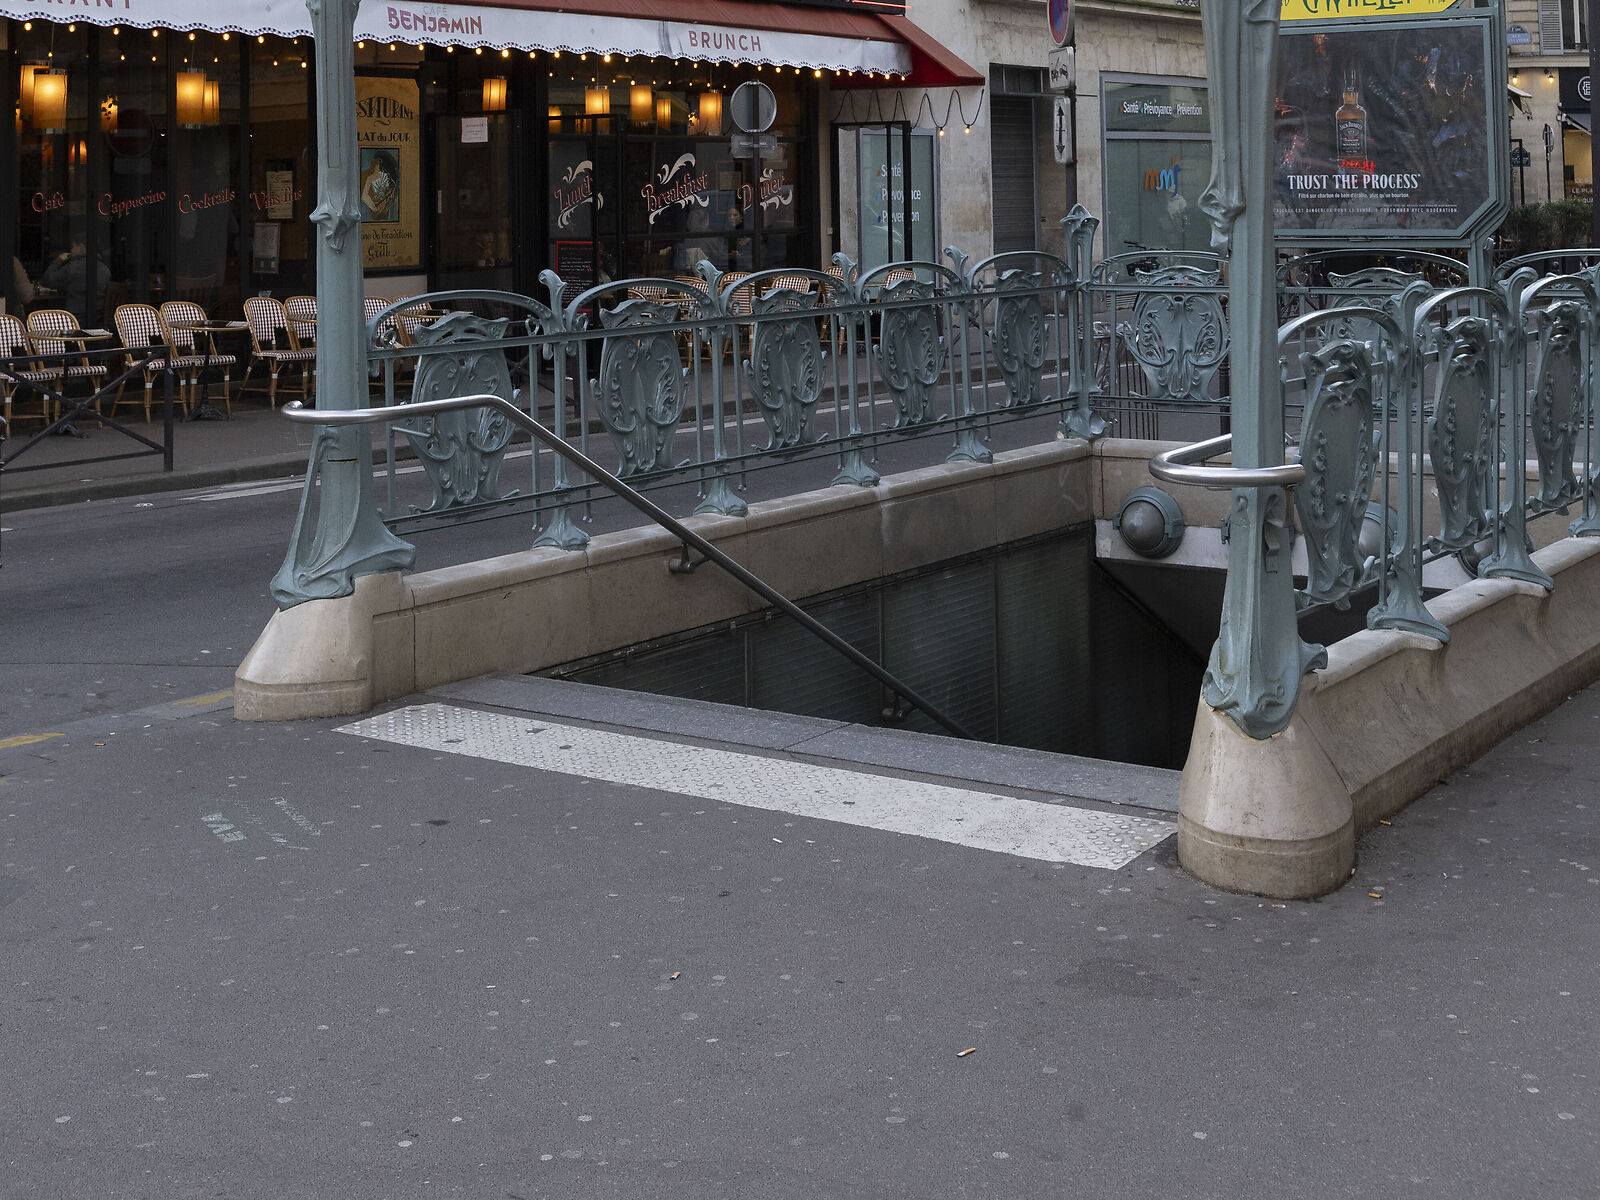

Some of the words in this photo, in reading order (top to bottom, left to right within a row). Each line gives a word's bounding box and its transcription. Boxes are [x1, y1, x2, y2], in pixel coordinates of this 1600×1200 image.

[387, 6, 483, 35] BENJAMIN
[423, 5, 448, 16] CAFÉ
[688, 30, 761, 52] BRUNCH
[1123, 100, 1139, 114] Santé
[1143, 100, 1172, 118] Prévoyance
[1176, 102, 1203, 116] Prévention
[357, 131, 376, 142] LAT
[881, 162, 902, 177] Snté
[641, 170, 708, 212] Breakfast
[1287, 174, 1329, 190] TRUST
[1332, 174, 1359, 189] THE
[32, 191, 65, 213] Café
[98, 189, 167, 219] Cappuccino
[178, 187, 236, 214] Cocktails
